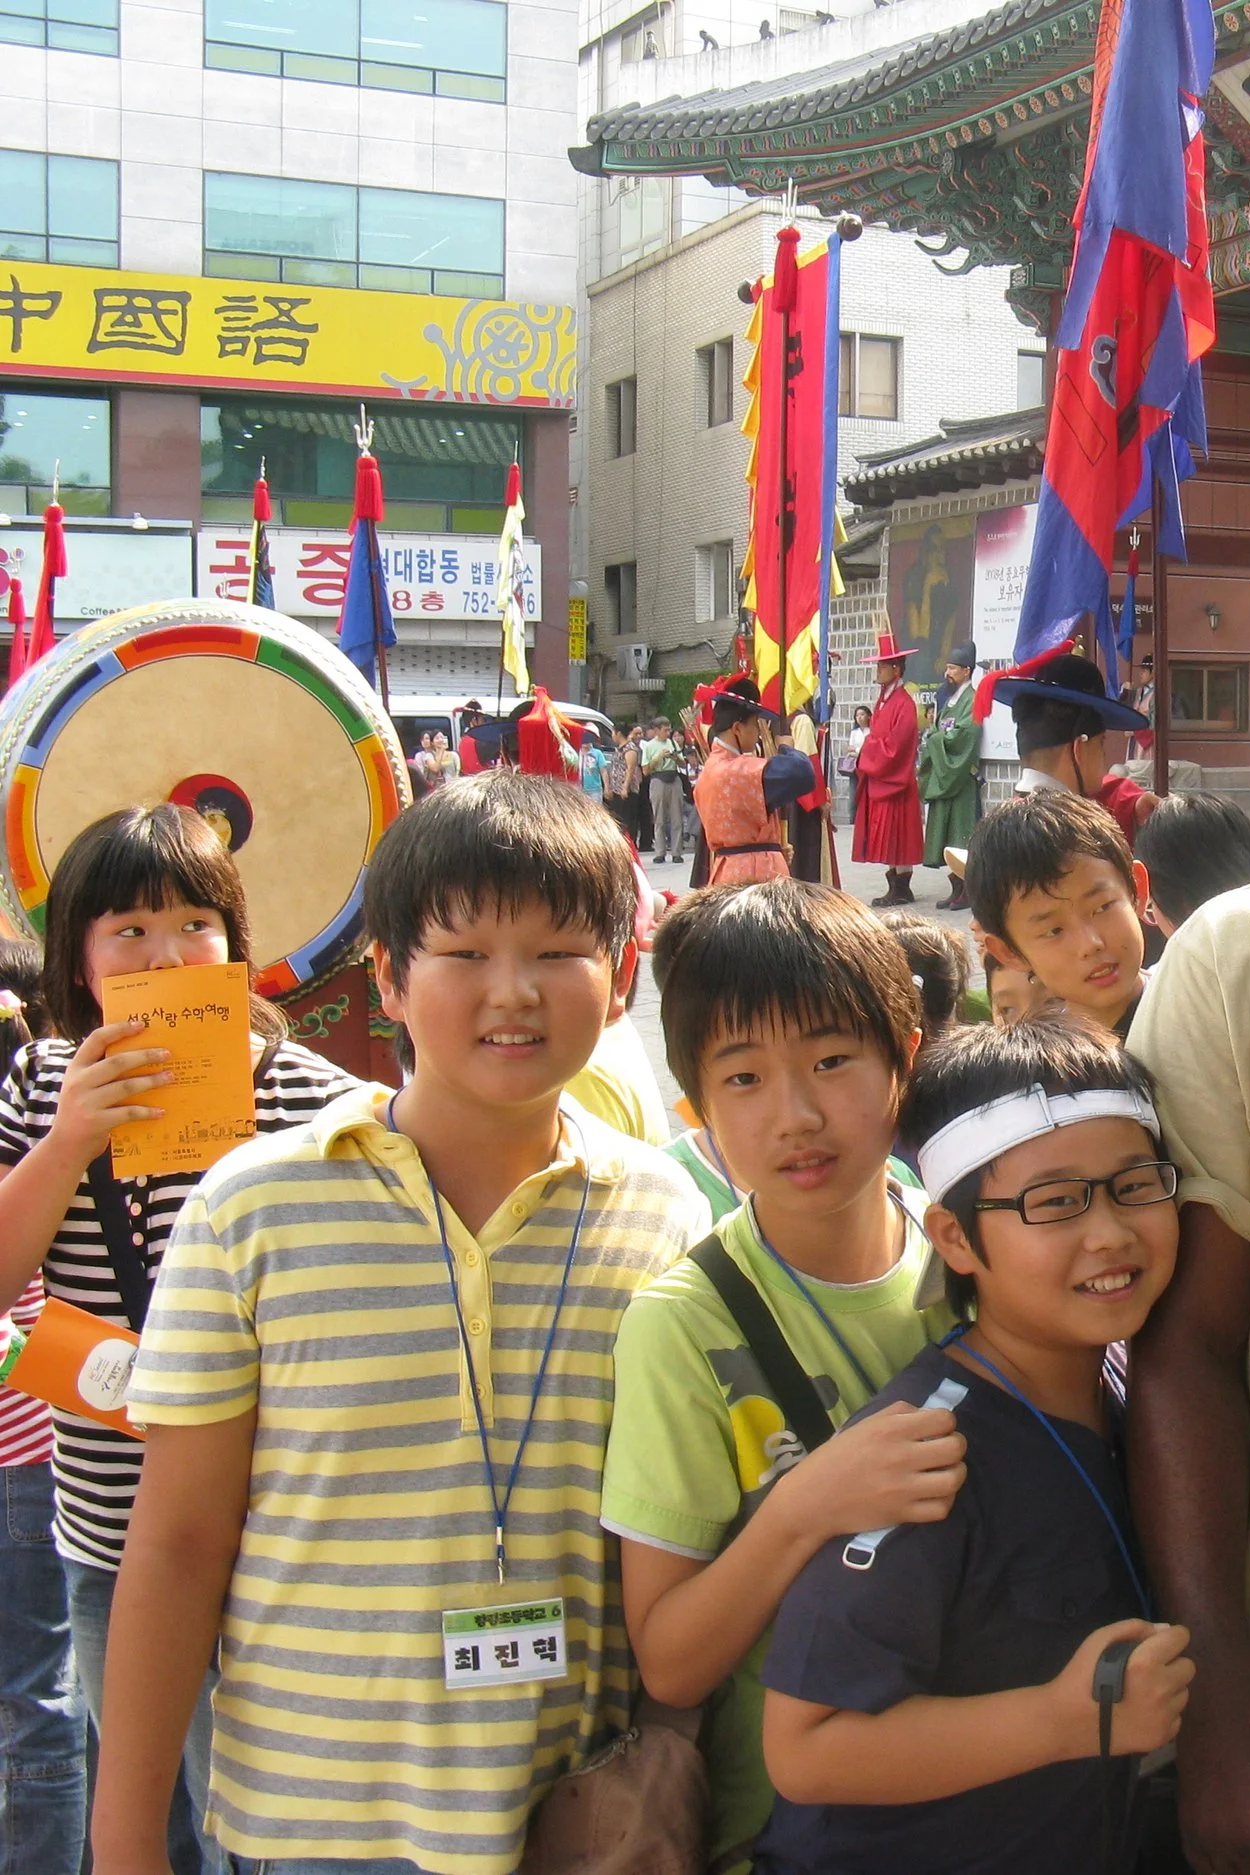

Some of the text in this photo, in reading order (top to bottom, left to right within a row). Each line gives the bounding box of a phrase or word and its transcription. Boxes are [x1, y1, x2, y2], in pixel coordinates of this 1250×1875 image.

[0, 273, 319, 367] 中國語
[181, 1003, 230, 1023] 수학여행
[552, 1605, 561, 1617] 6
